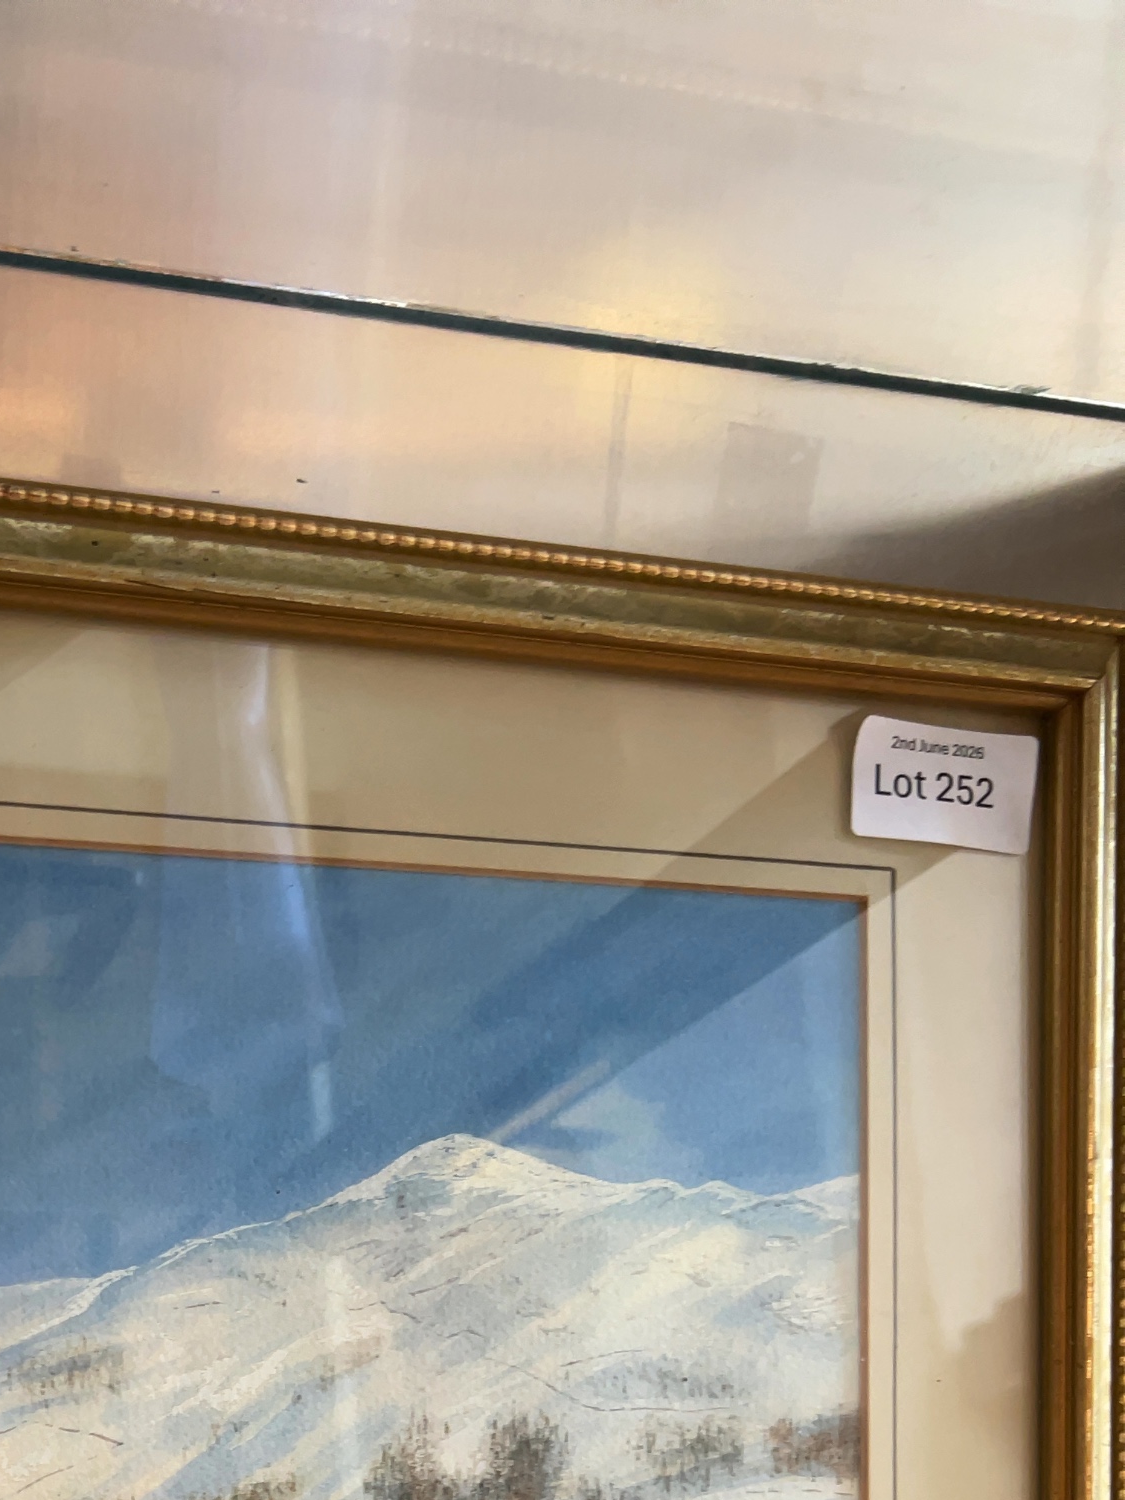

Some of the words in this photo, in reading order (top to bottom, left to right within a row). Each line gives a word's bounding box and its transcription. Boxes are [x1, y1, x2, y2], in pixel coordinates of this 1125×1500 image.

[891, 735, 916, 751] 2nd
[918, 739, 949, 756] June
[874, 763, 927, 800] Lot
[935, 772, 994, 809] 252
